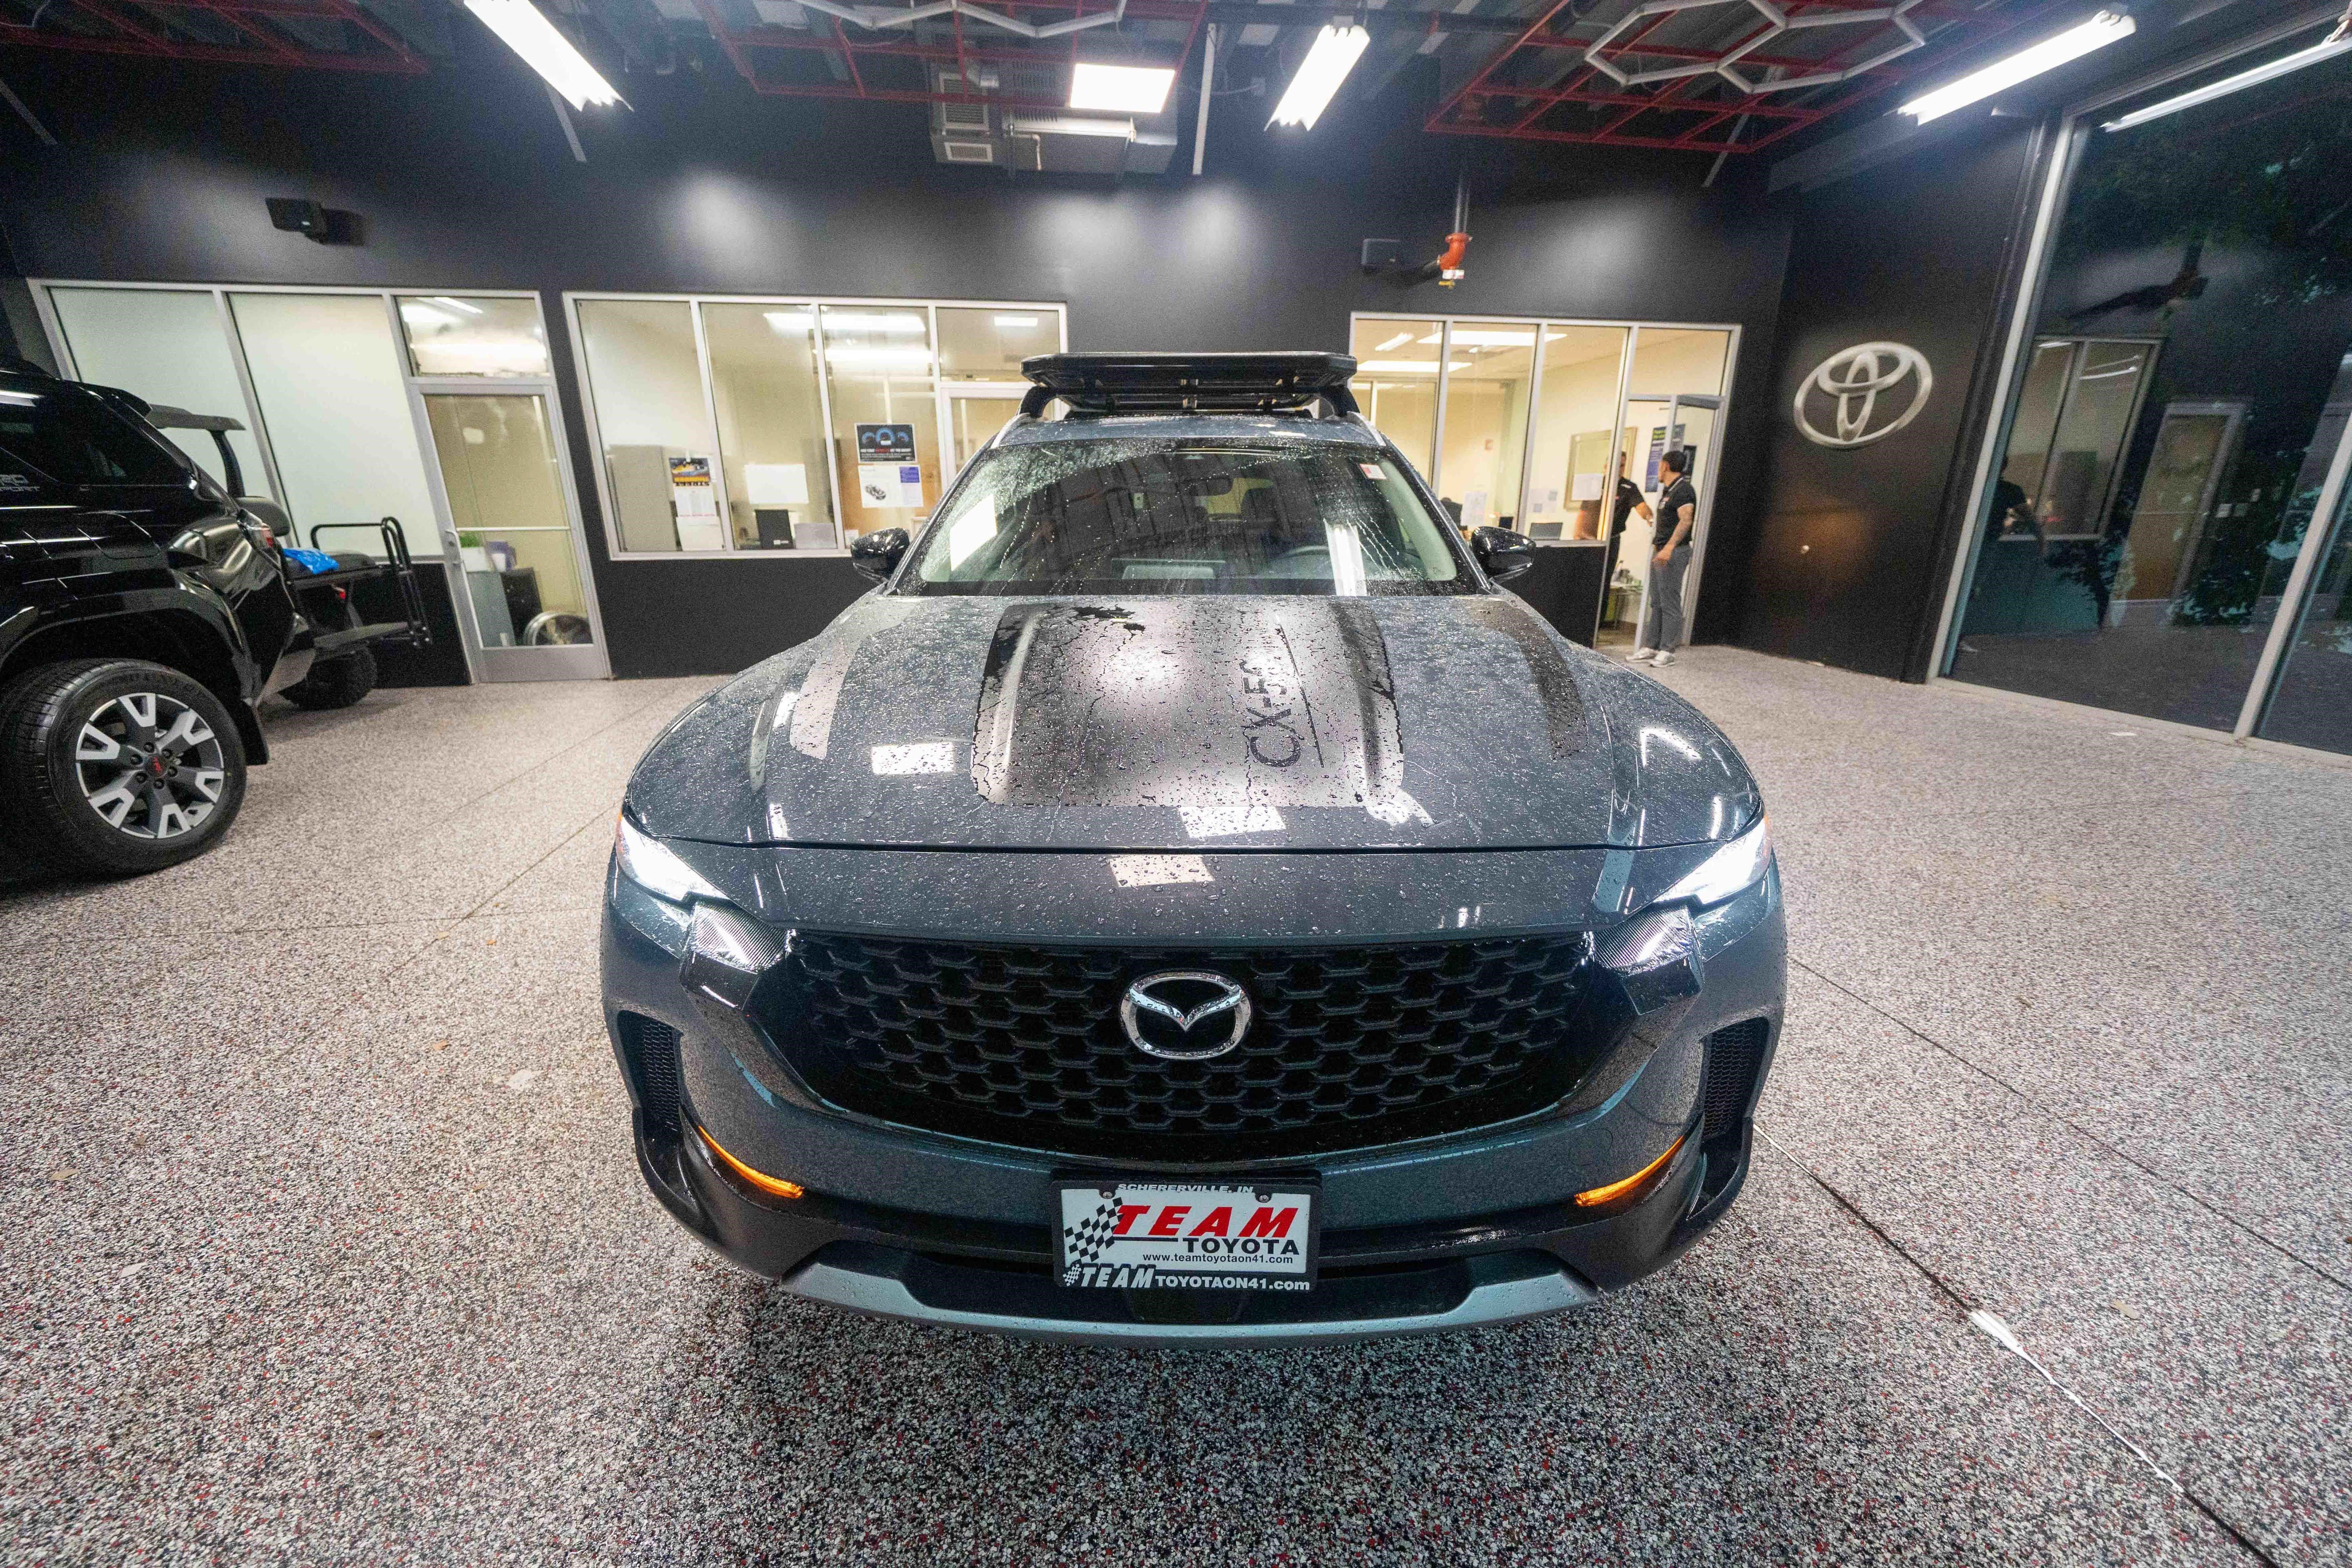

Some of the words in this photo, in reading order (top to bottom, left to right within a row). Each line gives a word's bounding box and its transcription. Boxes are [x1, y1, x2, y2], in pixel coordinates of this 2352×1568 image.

[1113, 1205, 1298, 1238] TEAM
[1183, 1237, 1299, 1255] TOYOTA
[1143, 1254, 1293, 1264] www.teamtoyotaon41.com
[1081, 1267, 1156, 1288] TEAM
[1155, 1276, 1310, 1290] TOYOTAON41.com
